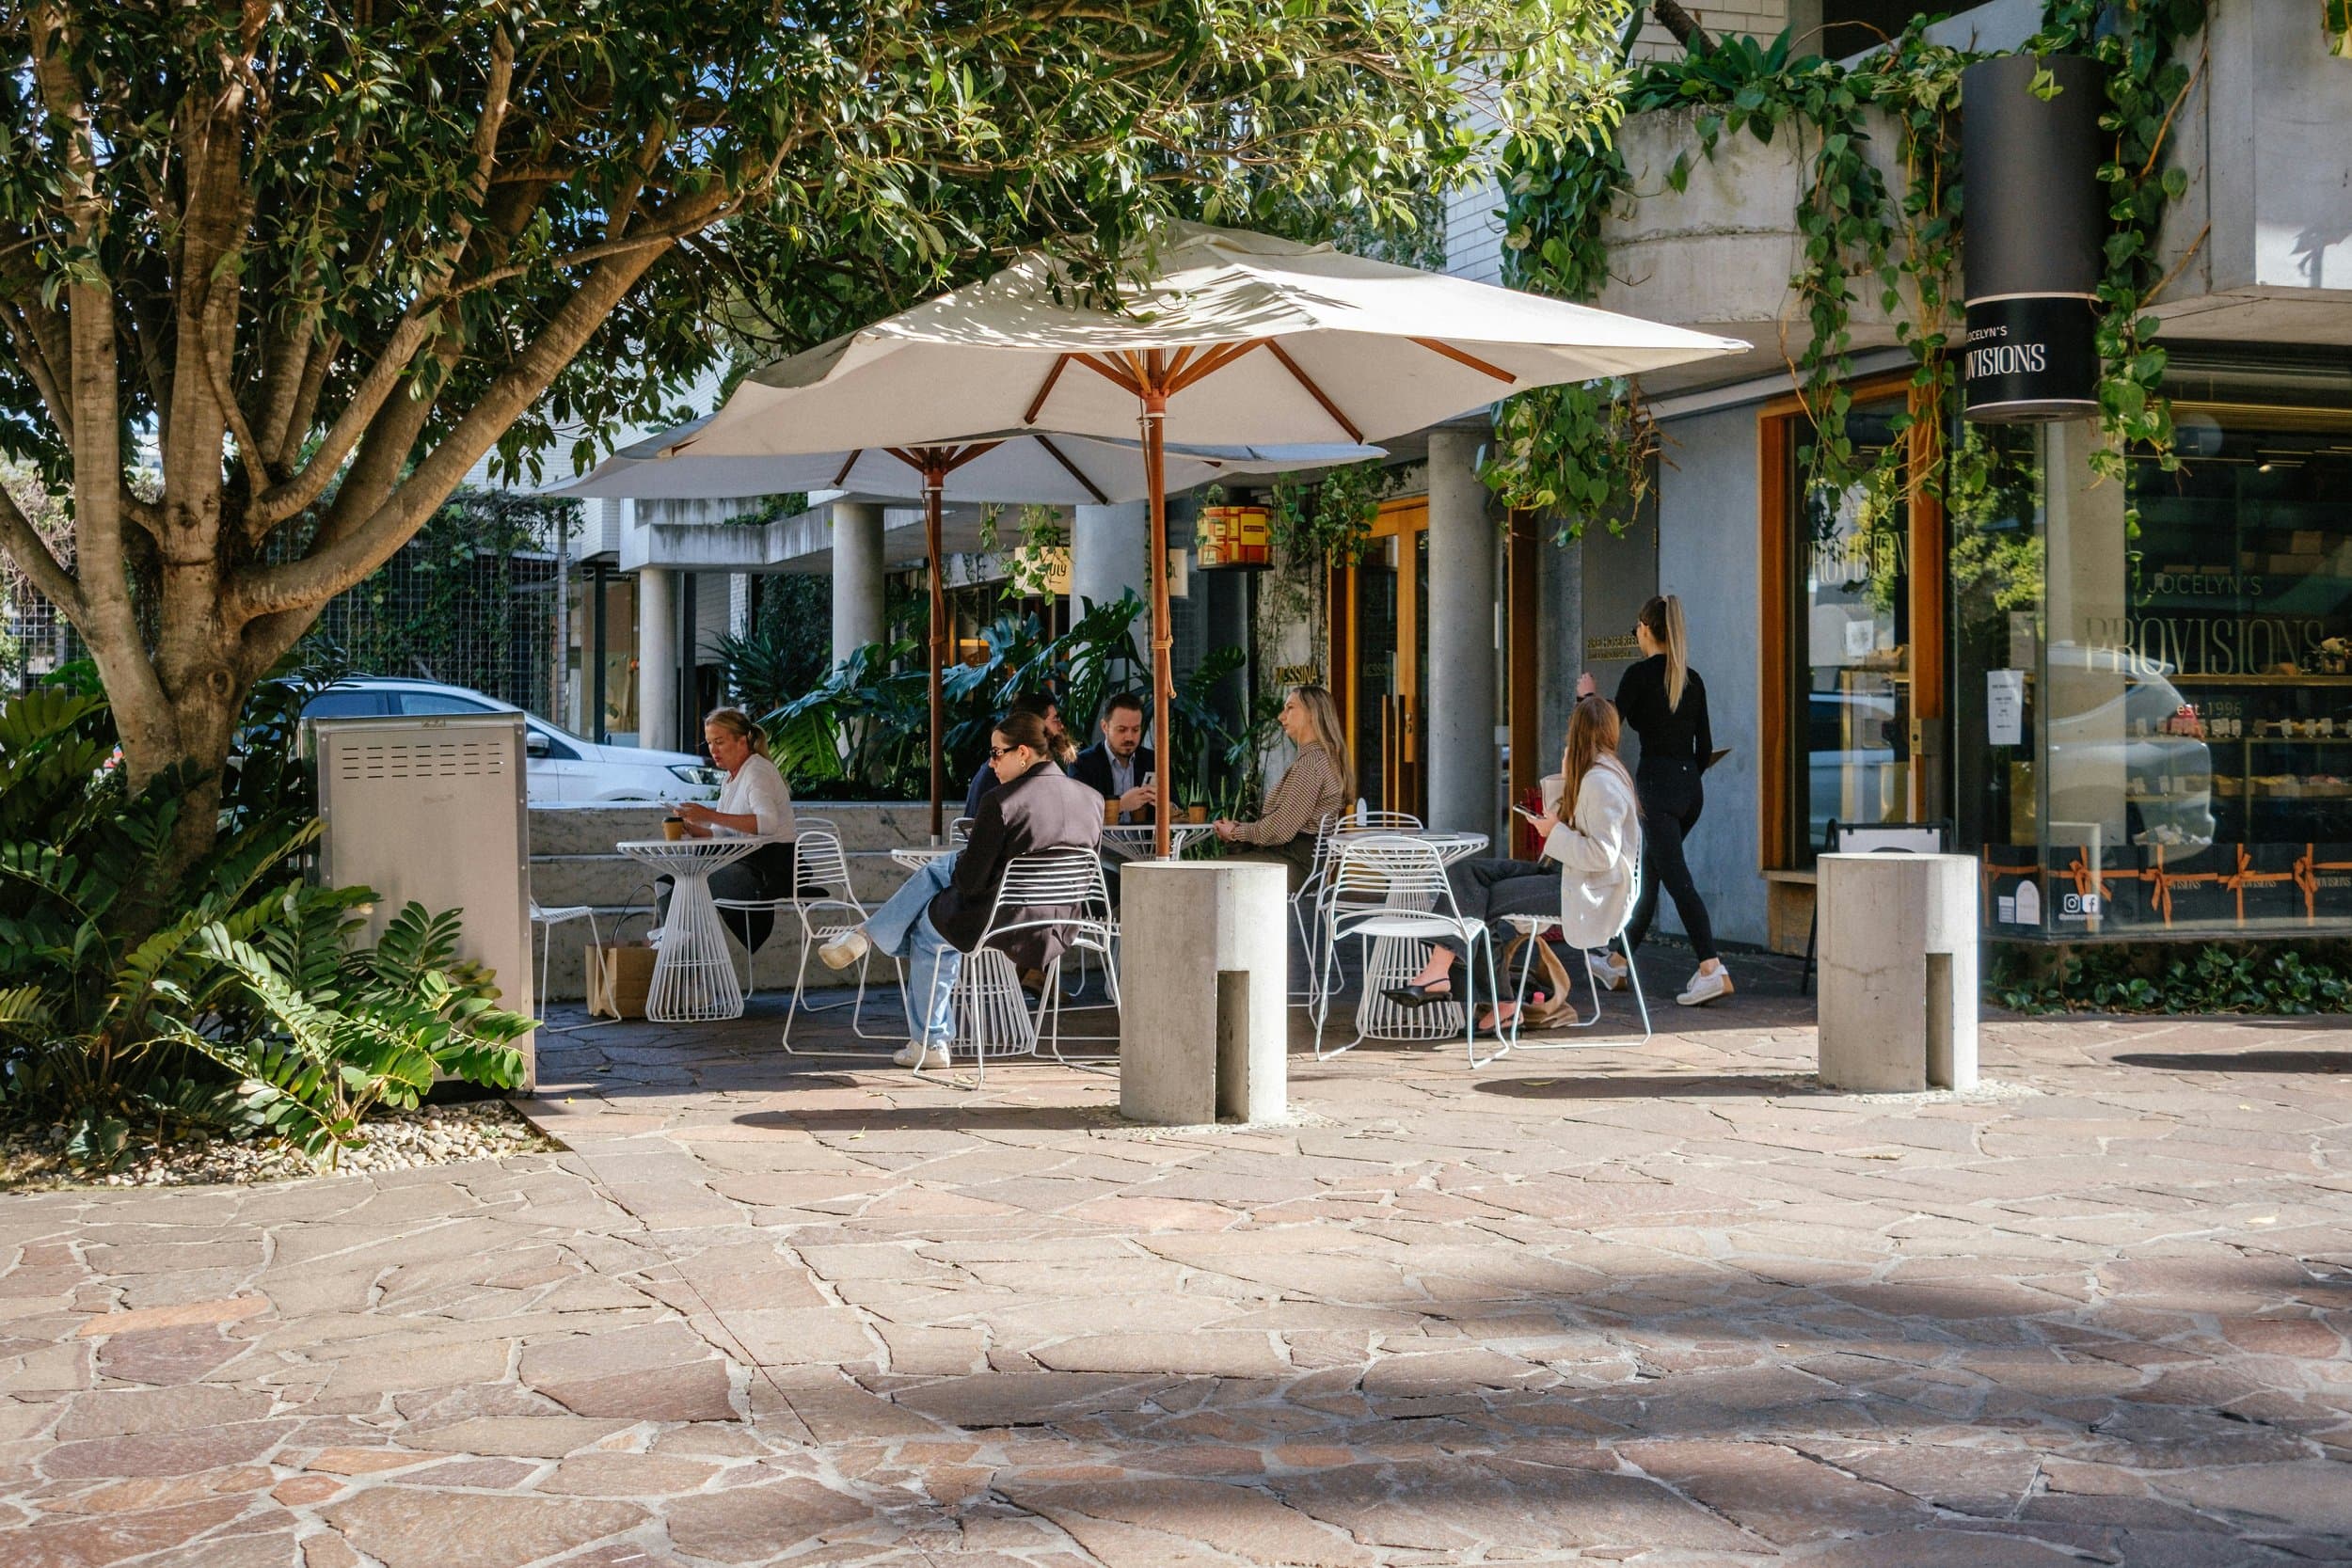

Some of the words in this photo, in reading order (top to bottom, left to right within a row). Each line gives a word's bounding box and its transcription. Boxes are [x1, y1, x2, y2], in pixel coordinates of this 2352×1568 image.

[1965, 343, 2046, 381] OVISIONS
[2148, 573, 2264, 595] JOCELYN'S
[2085, 617, 2327, 676] PROVISIONS
